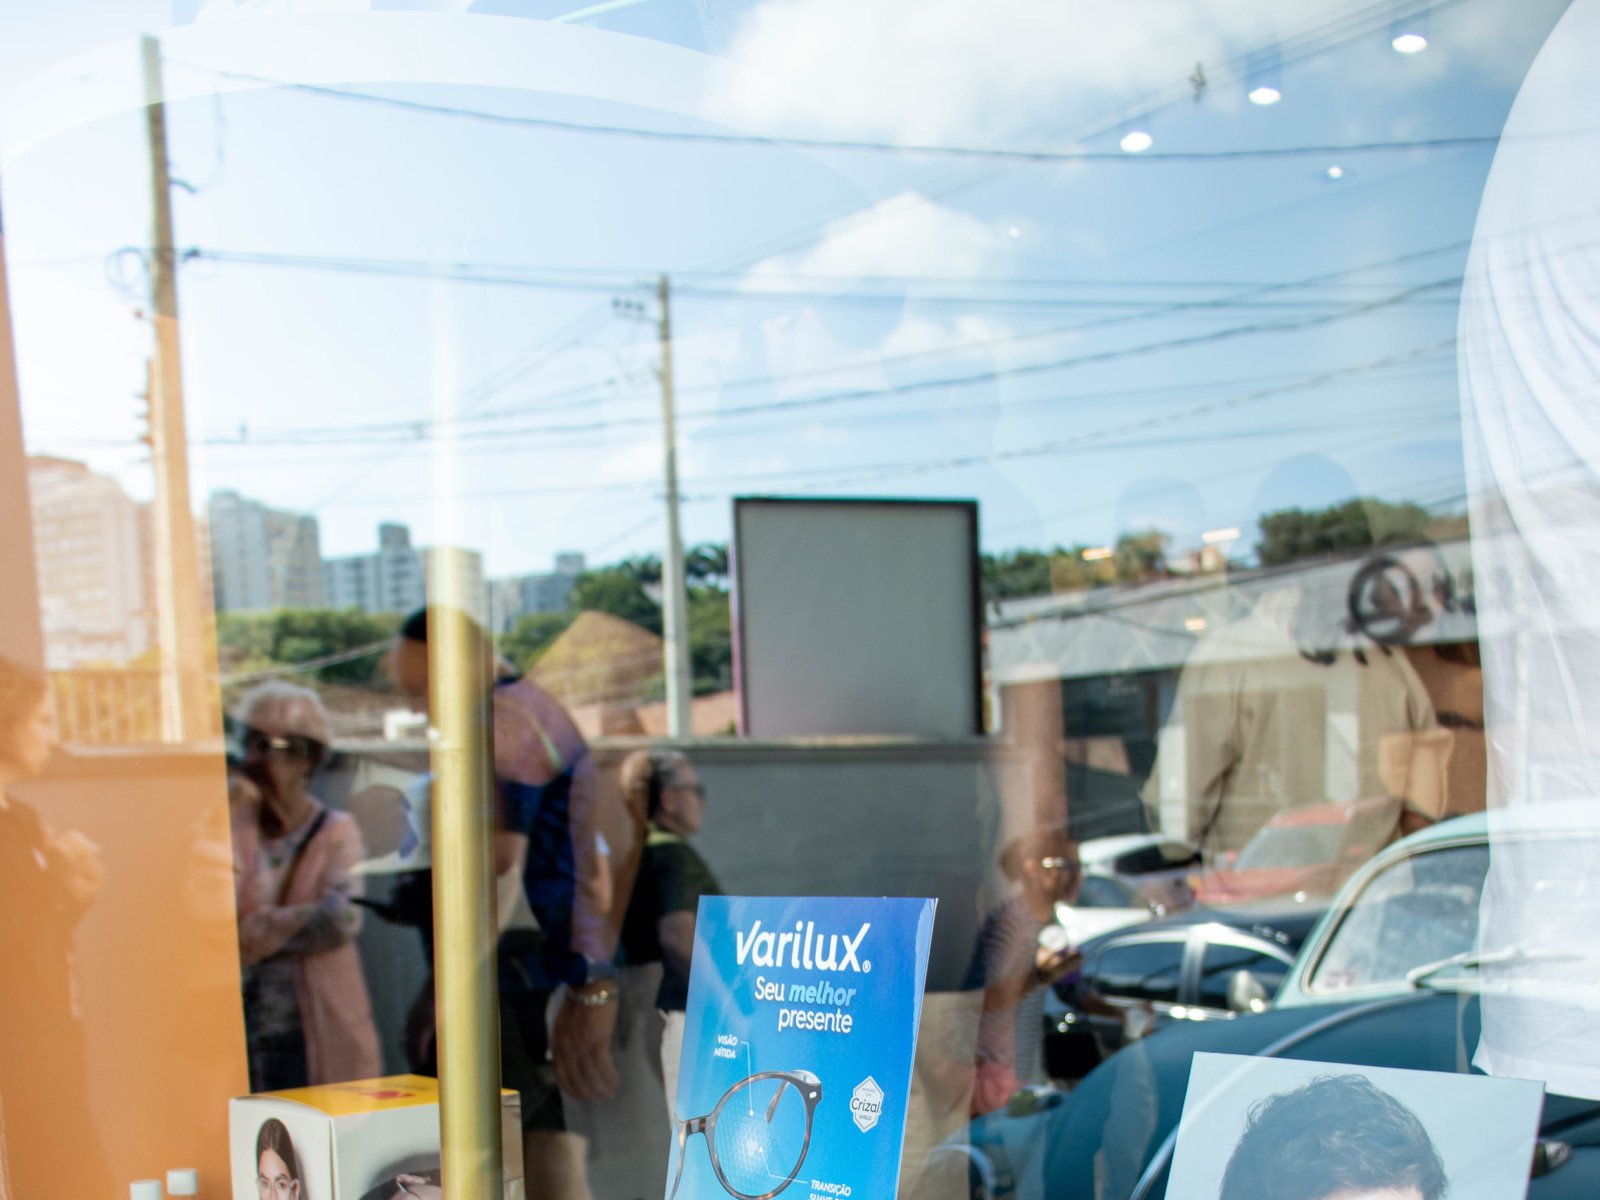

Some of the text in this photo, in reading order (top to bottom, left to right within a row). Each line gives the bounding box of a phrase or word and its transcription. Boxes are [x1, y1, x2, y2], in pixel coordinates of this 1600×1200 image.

[755, 975, 857, 1007] Seu melhor
[778, 1008, 854, 1034] presente
[717, 1034, 738, 1046] VISÃO
[851, 1097, 881, 1113] Crizal
[811, 1179, 852, 1197] TRANSIÇÃO
